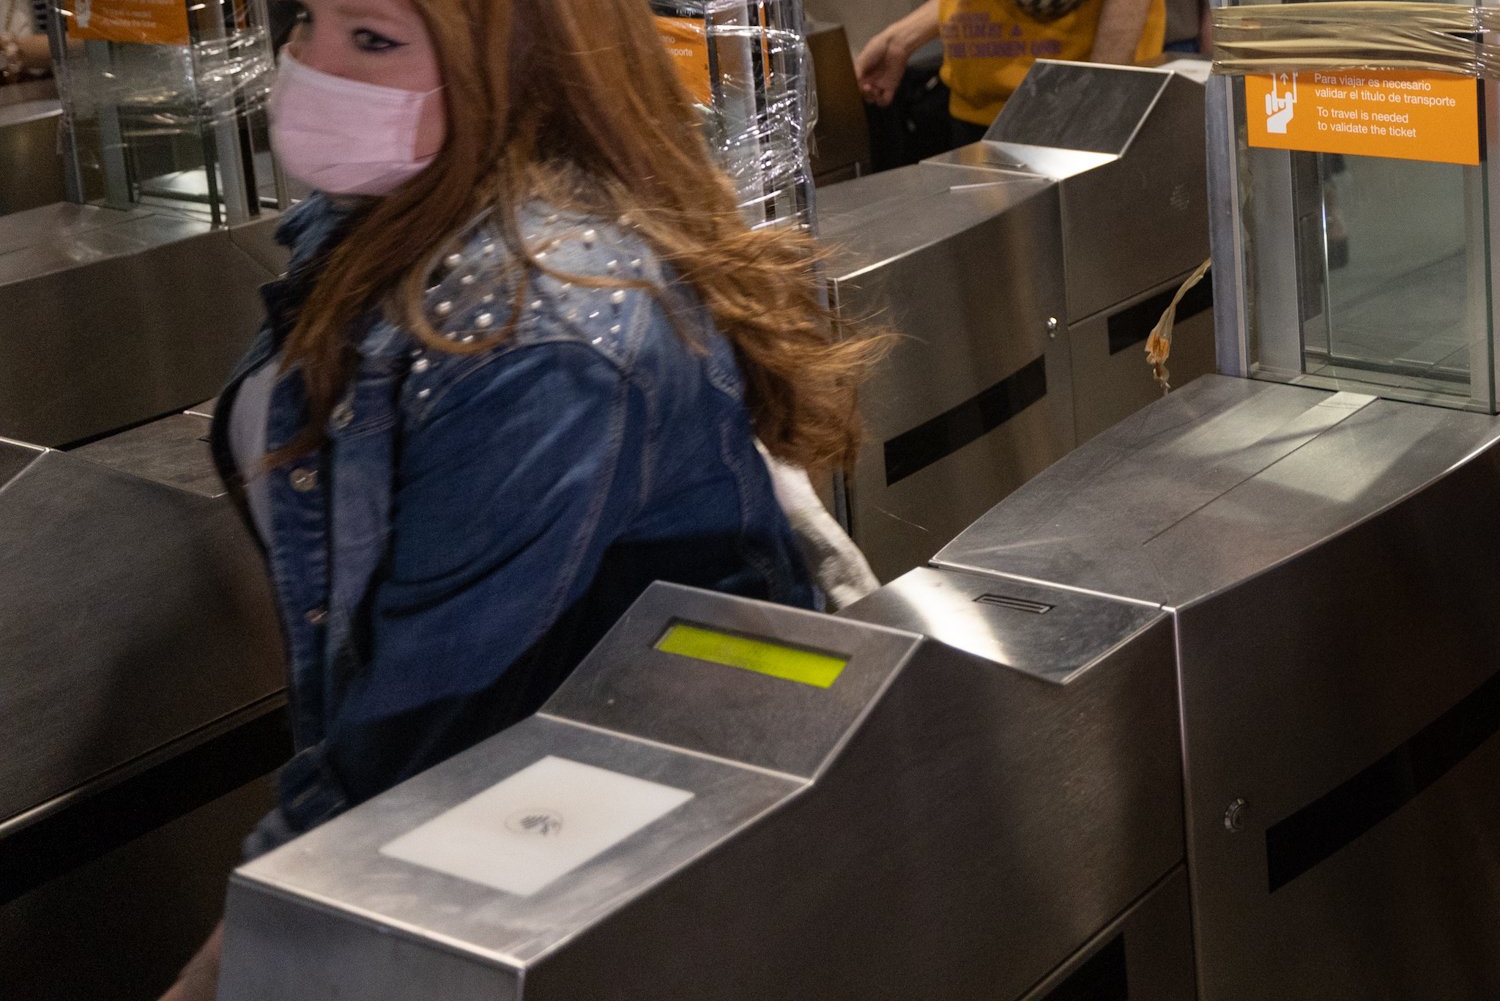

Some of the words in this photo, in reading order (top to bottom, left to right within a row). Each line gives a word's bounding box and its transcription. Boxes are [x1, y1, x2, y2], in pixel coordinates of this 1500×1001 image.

[1314, 72, 1337, 85] Para
[1339, 74, 1365, 88] viajar
[1368, 79, 1380, 88] es
[1382, 79, 1431, 92] necesario
[1315, 88, 1347, 99] validar
[1349, 89, 1358, 99] el
[1389, 92, 1401, 103] de
[1403, 94, 1456, 108] transporte
[1316, 106, 1329, 118] To
[1331, 107, 1358, 119] travel
[1360, 109, 1369, 120] is
[1371, 111, 1409, 124] needed
[1317, 120, 1328, 131] to
[1330, 121, 1369, 134] validate
[1370, 124, 1386, 136] the
[1389, 126, 1417, 138] ticket
